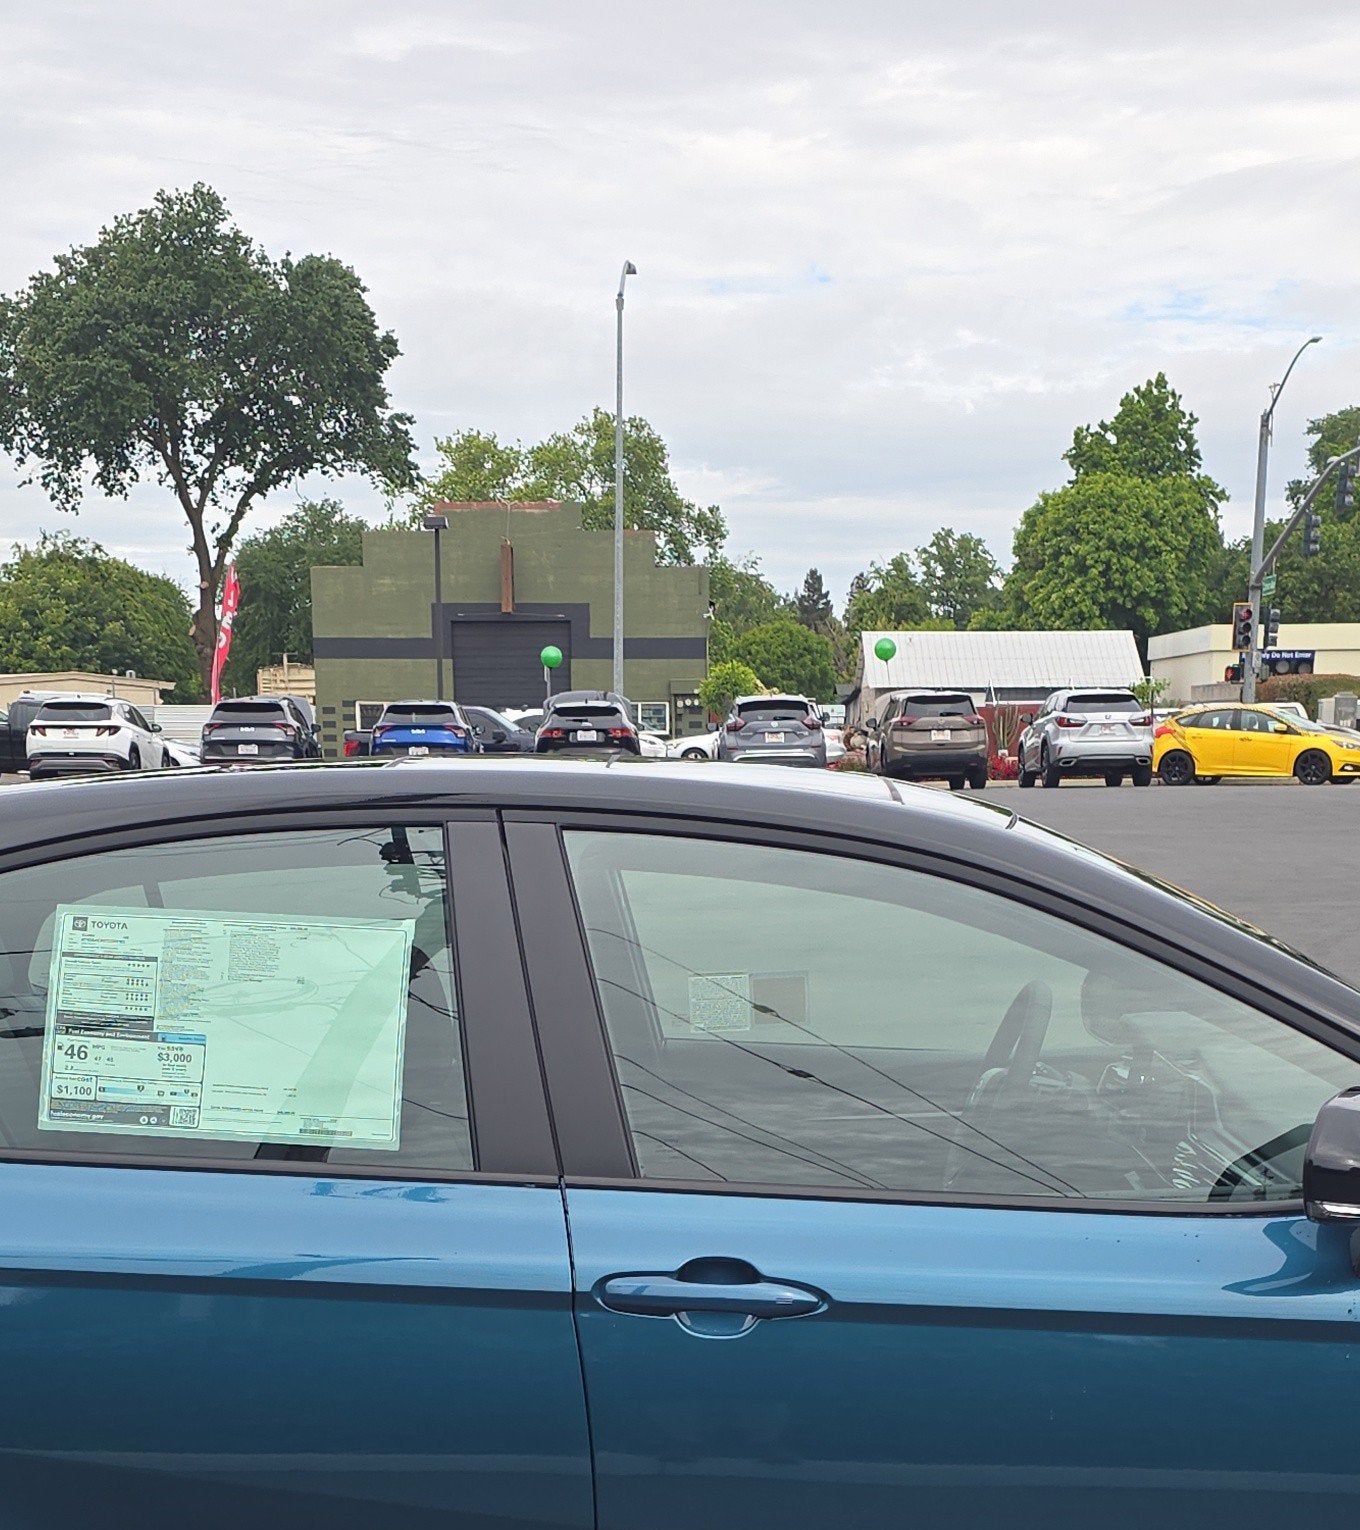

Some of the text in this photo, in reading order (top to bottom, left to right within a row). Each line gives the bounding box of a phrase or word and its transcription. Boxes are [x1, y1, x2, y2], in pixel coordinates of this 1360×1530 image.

[91, 921, 128, 930] TOYOTA
[65, 1044, 88, 1060] 46
[157, 1053, 193, 1063] $3,000
[56, 1085, 92, 1096] $1,100
